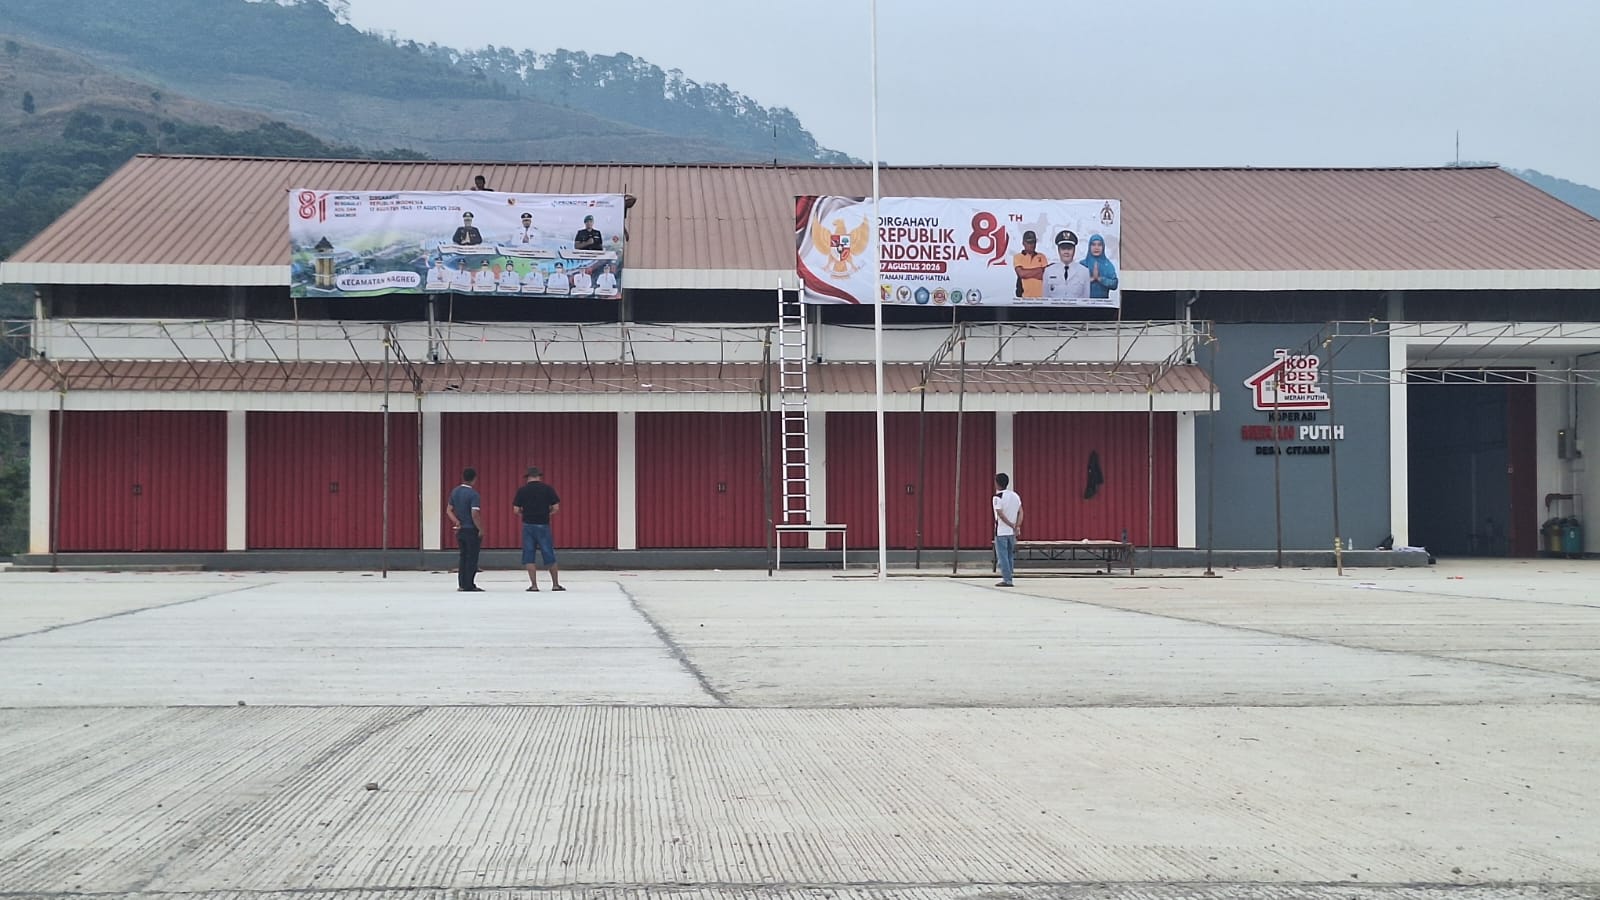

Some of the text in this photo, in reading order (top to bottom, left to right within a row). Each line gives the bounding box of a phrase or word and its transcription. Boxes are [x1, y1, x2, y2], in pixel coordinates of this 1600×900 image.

[877, 216, 939, 227] DIRGAHAYU
[1009, 214, 1023, 222] TH
[879, 227, 955, 244] REPUBLIK
[969, 211, 1009, 268] 81
[879, 244, 969, 261] NDONESIA
[887, 262, 920, 271] AGUSTUS
[921, 263, 941, 271] 2026
[1286, 358, 1317, 369] KOP
[1287, 371, 1315, 381] DES
[1287, 383, 1315, 394] KEL
[1300, 425, 1344, 440] PUTIH
[1286, 446, 1330, 455] CITAMAN
